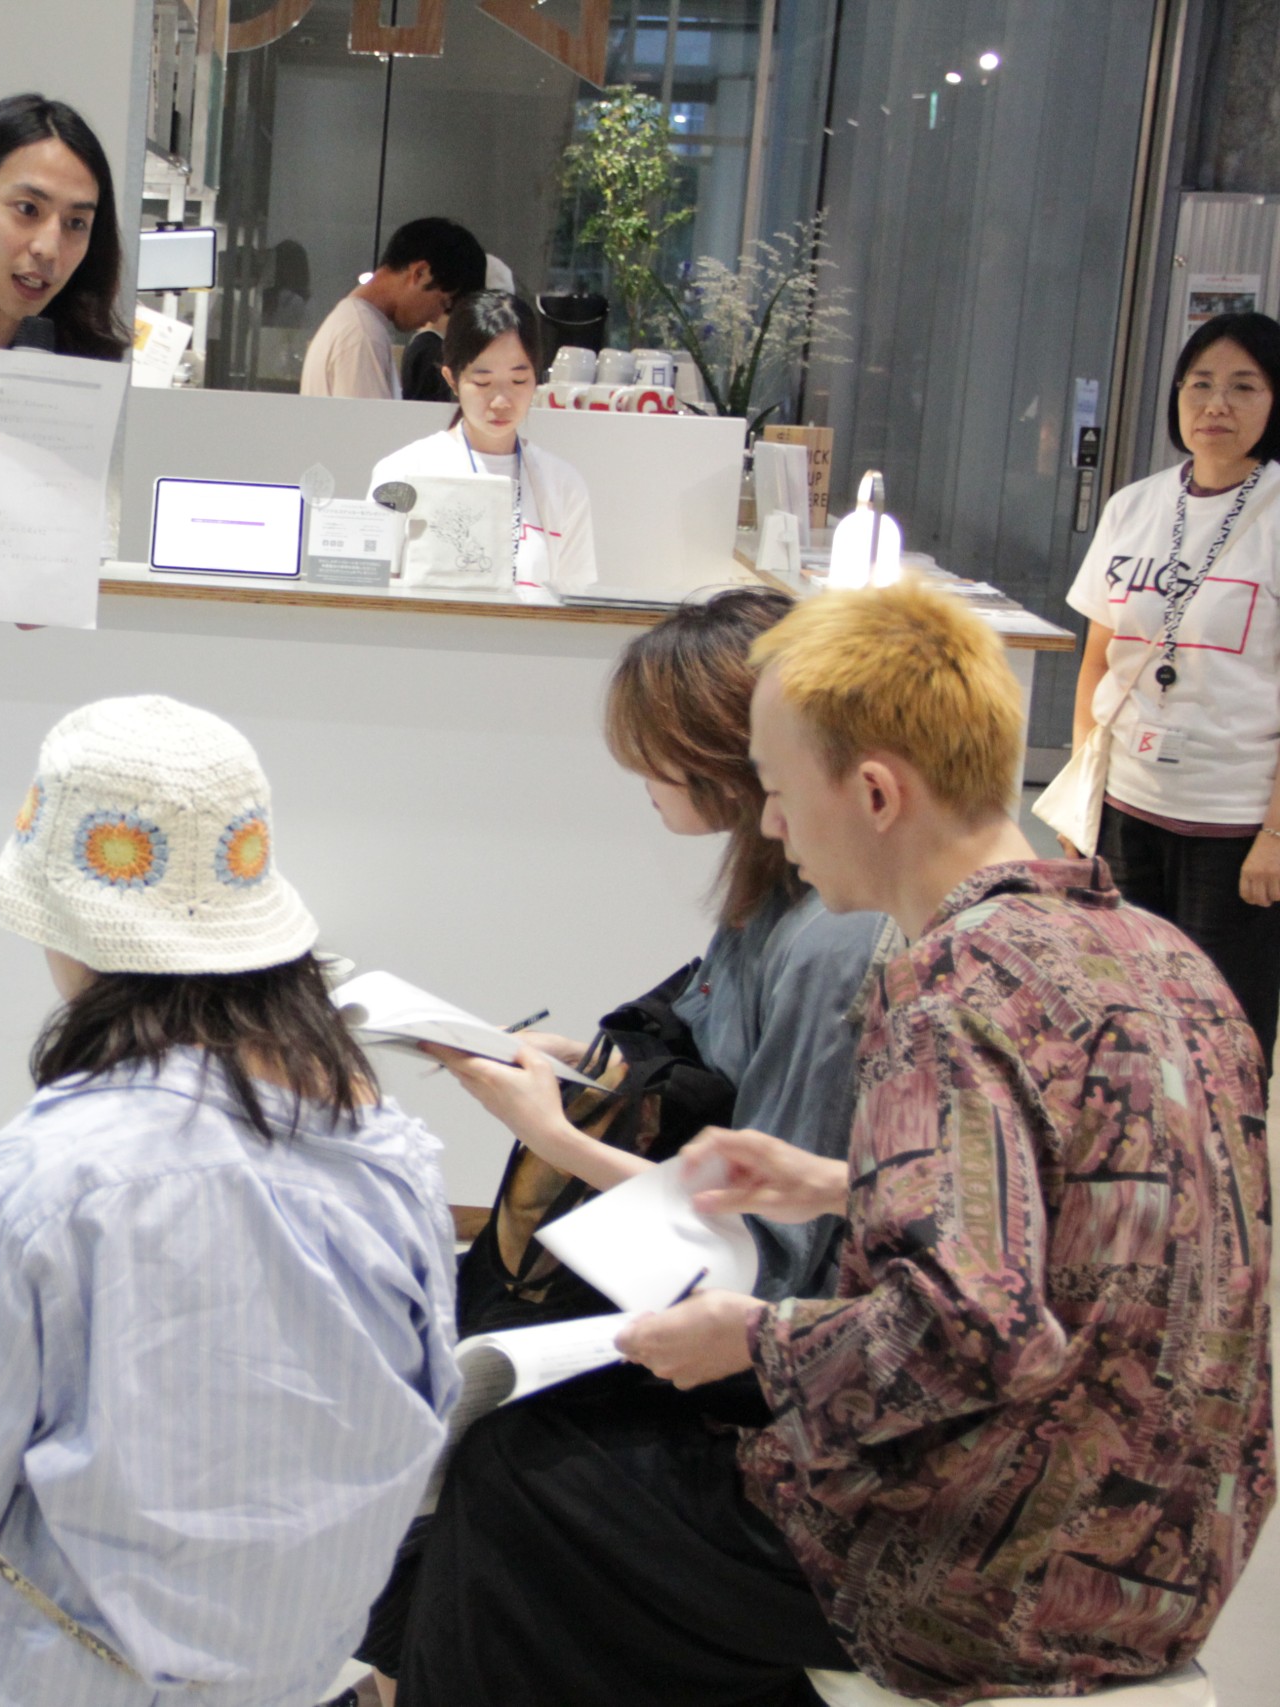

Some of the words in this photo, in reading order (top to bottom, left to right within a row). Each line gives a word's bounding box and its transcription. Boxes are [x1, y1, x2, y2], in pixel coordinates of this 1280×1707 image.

[807, 450, 830, 465] ICK
[807, 472, 822, 486] UP
[808, 492, 828, 507] ERE
[1105, 556, 1195, 599] BUG
